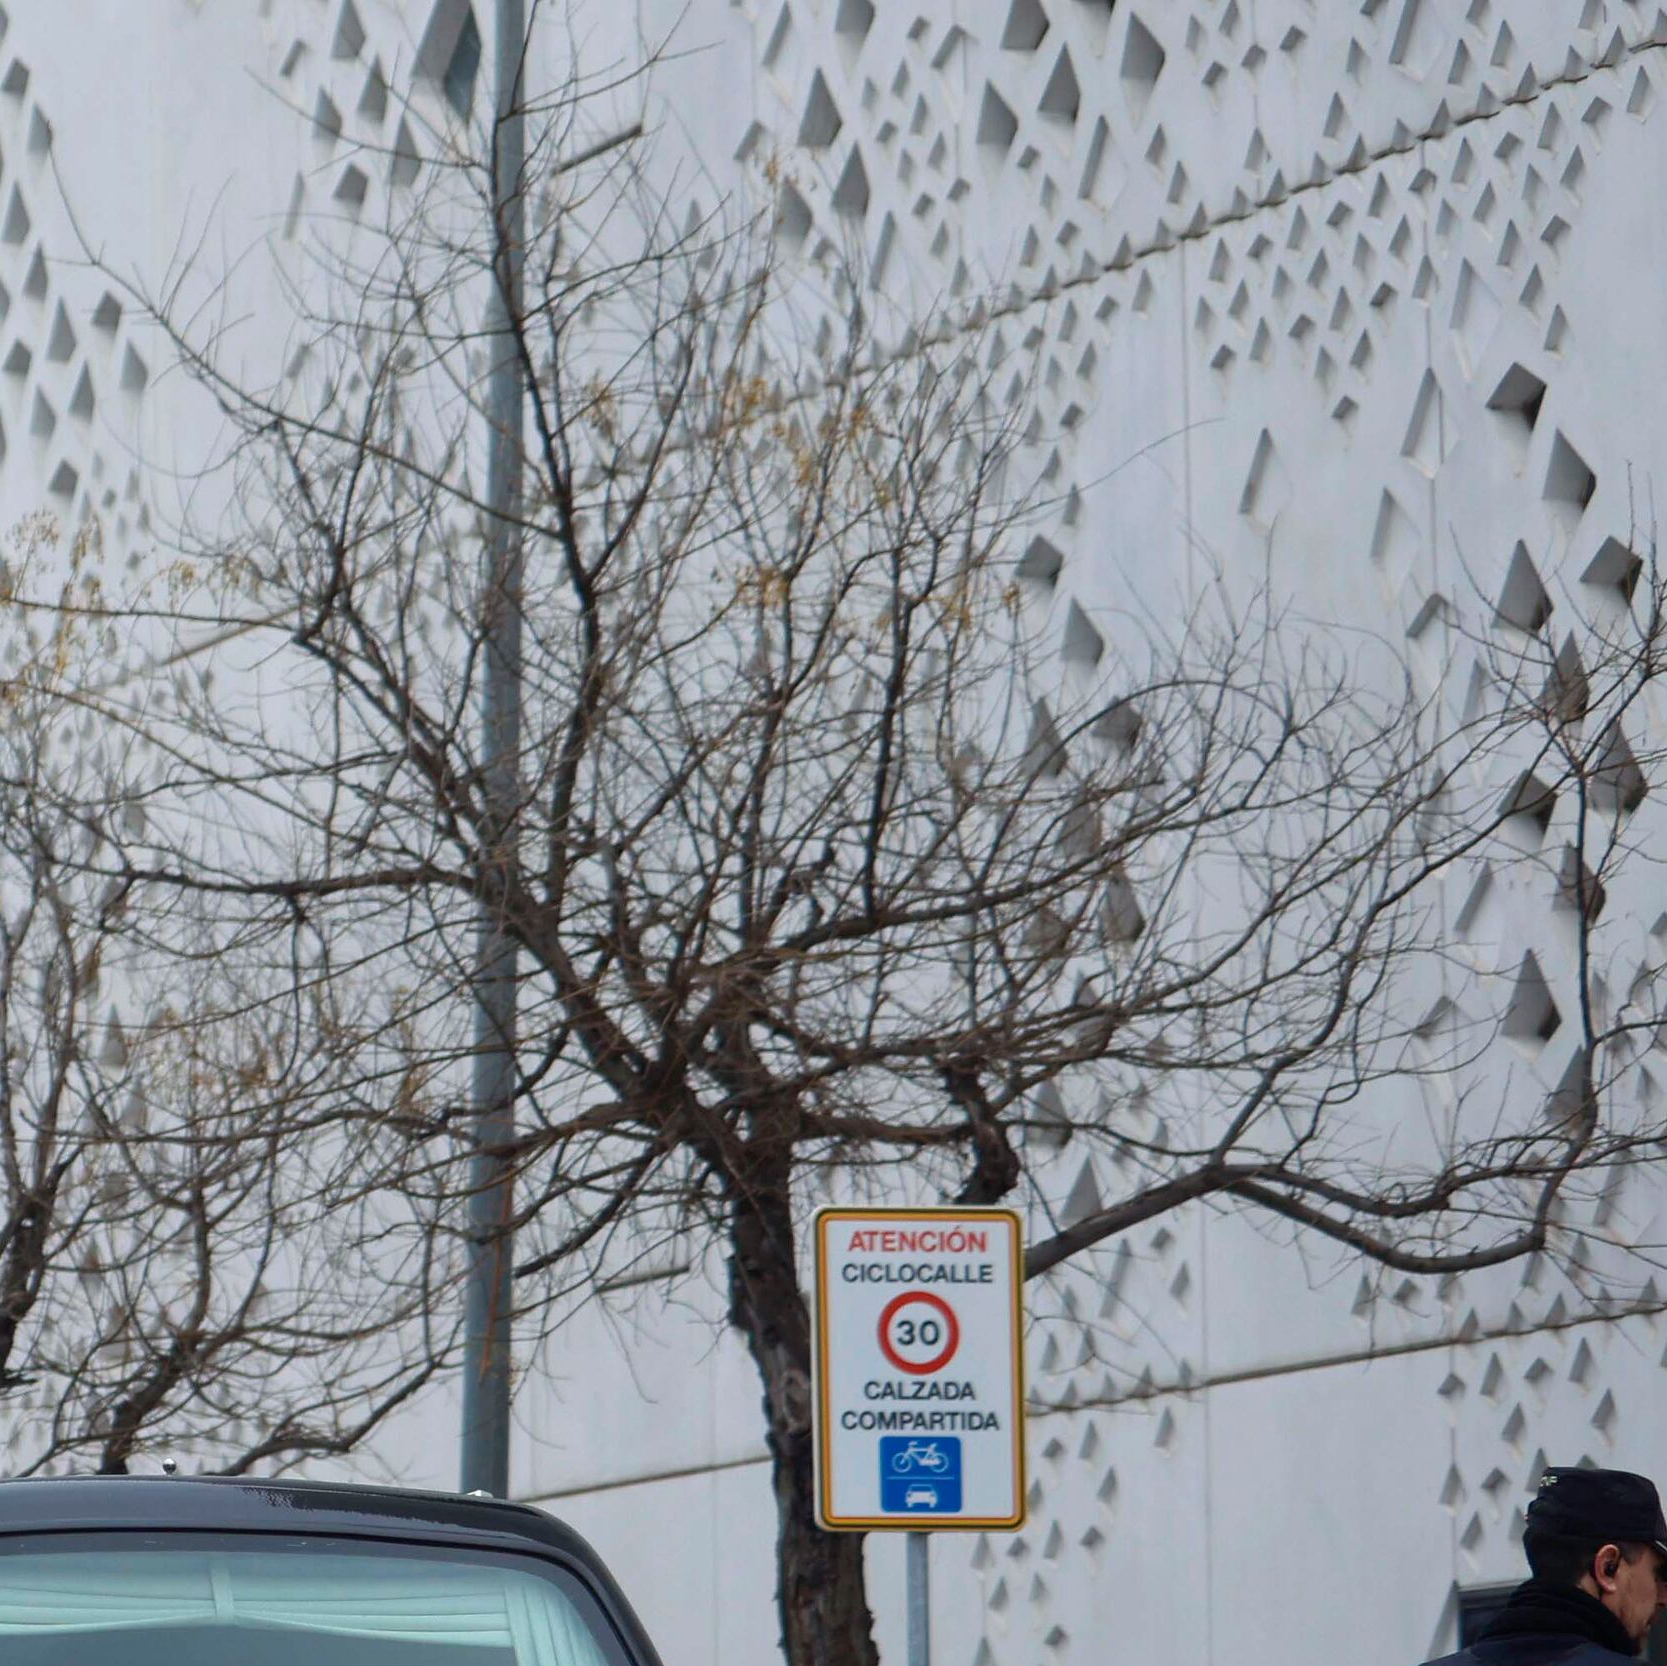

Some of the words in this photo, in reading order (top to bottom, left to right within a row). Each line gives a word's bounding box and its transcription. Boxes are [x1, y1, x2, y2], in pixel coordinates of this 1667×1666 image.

[848, 1226, 987, 1253] ATENCIÓN
[842, 1263, 993, 1283] CICLOCALLE
[896, 1320, 940, 1346] 30
[864, 1381, 976, 1400] CALZADA
[841, 1411, 1000, 1431] COMPARTIDA
